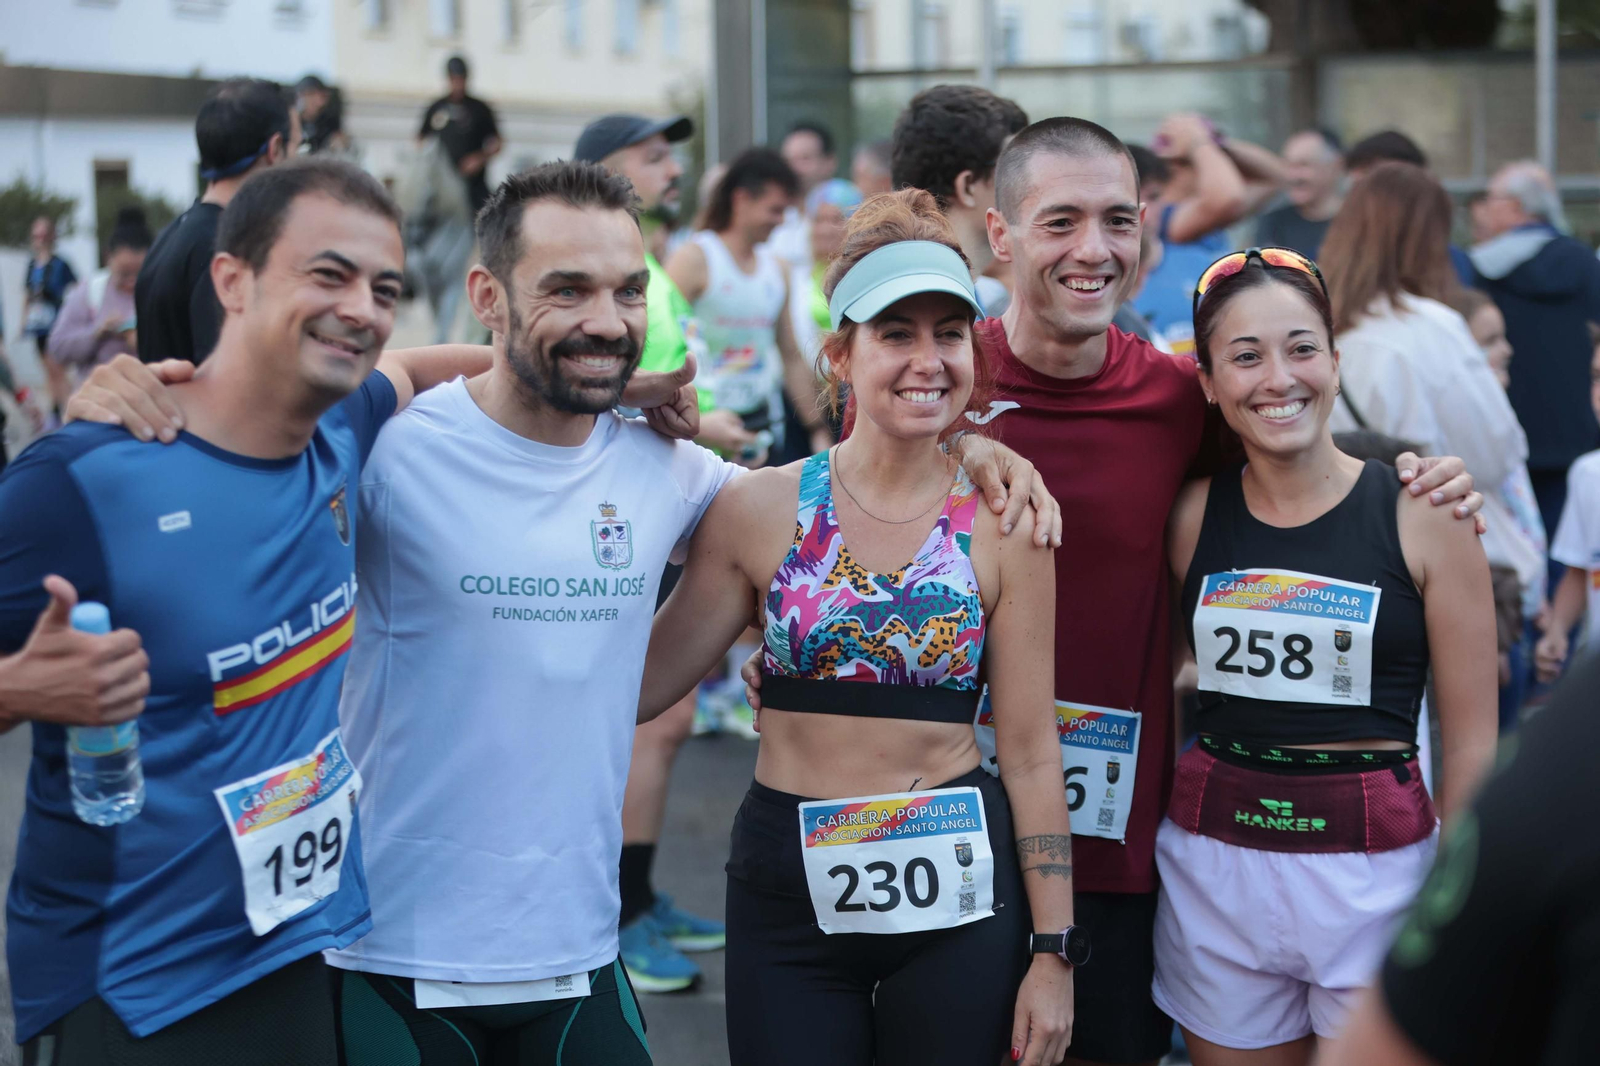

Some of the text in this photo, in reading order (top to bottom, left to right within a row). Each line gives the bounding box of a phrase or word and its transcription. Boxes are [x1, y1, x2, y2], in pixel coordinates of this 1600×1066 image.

[460, 572, 646, 598] COLEGIO SAN JOSÉ
[1217, 580, 1361, 608] CARRERA POPULAR
[492, 606, 618, 622] FUNDACIÓN XAFER
[1210, 594, 1366, 620] ASOCIACION SANTO ANGEL
[1213, 626, 1314, 681] 258
[1069, 717, 1128, 737] POPULAR
[1064, 732, 1099, 746] SANTO
[1101, 737, 1130, 750] ANGEL
[238, 774, 314, 812] CARRERA
[1062, 766, 1089, 812] 6
[816, 802, 968, 828] CARRERA POPULAR
[1235, 810, 1327, 831] HANKER
[814, 818, 978, 843] ASOCIACION SANTO ANGEL
[264, 817, 342, 897] 199
[827, 856, 939, 912] 230
